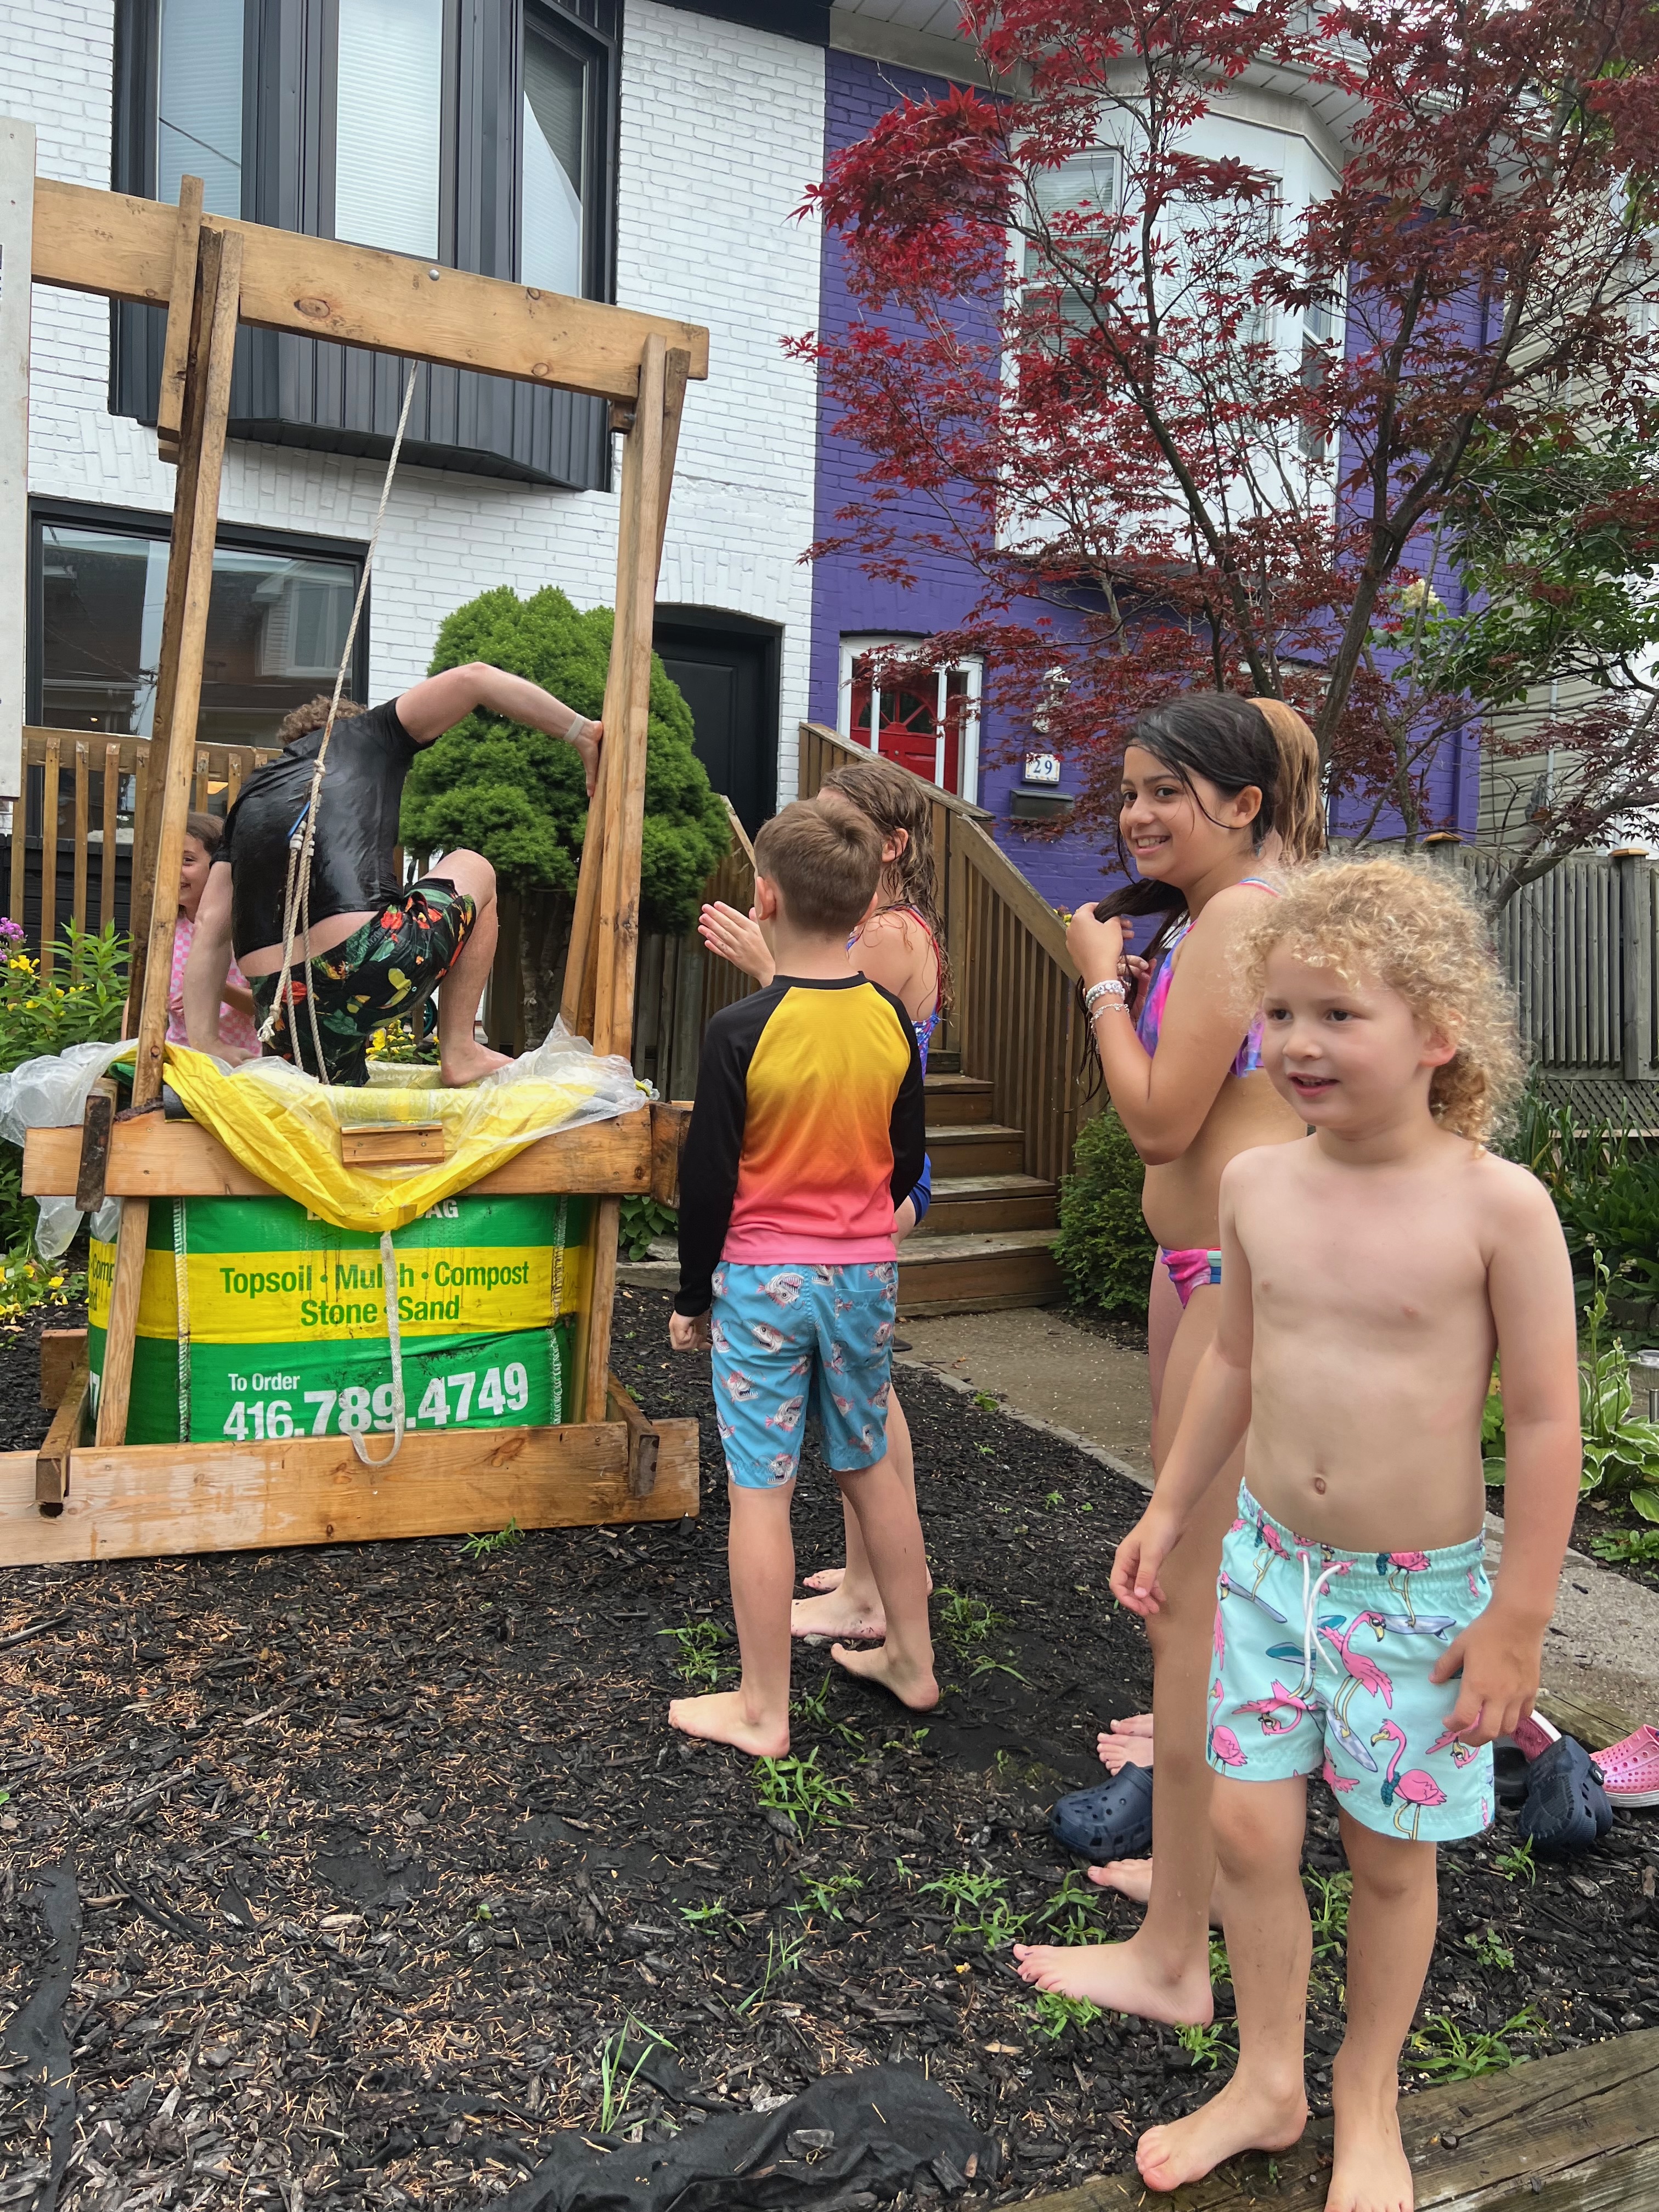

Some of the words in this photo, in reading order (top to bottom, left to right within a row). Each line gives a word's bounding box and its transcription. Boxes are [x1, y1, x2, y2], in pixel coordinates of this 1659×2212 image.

[1033, 759, 1053, 775] 29
[415, 1198, 459, 1220] AG
[92, 1253, 115, 1288] Comp
[219, 1265, 312, 1299] Topsoil
[336, 1263, 414, 1290] Mulh
[435, 1261, 529, 1290] Compost
[301, 1300, 377, 1326] Stone
[398, 1295, 460, 1322] Sand
[228, 1373, 247, 1391] To
[252, 1373, 300, 1390] Order
[223, 1362, 528, 1441] 416.789.4749
